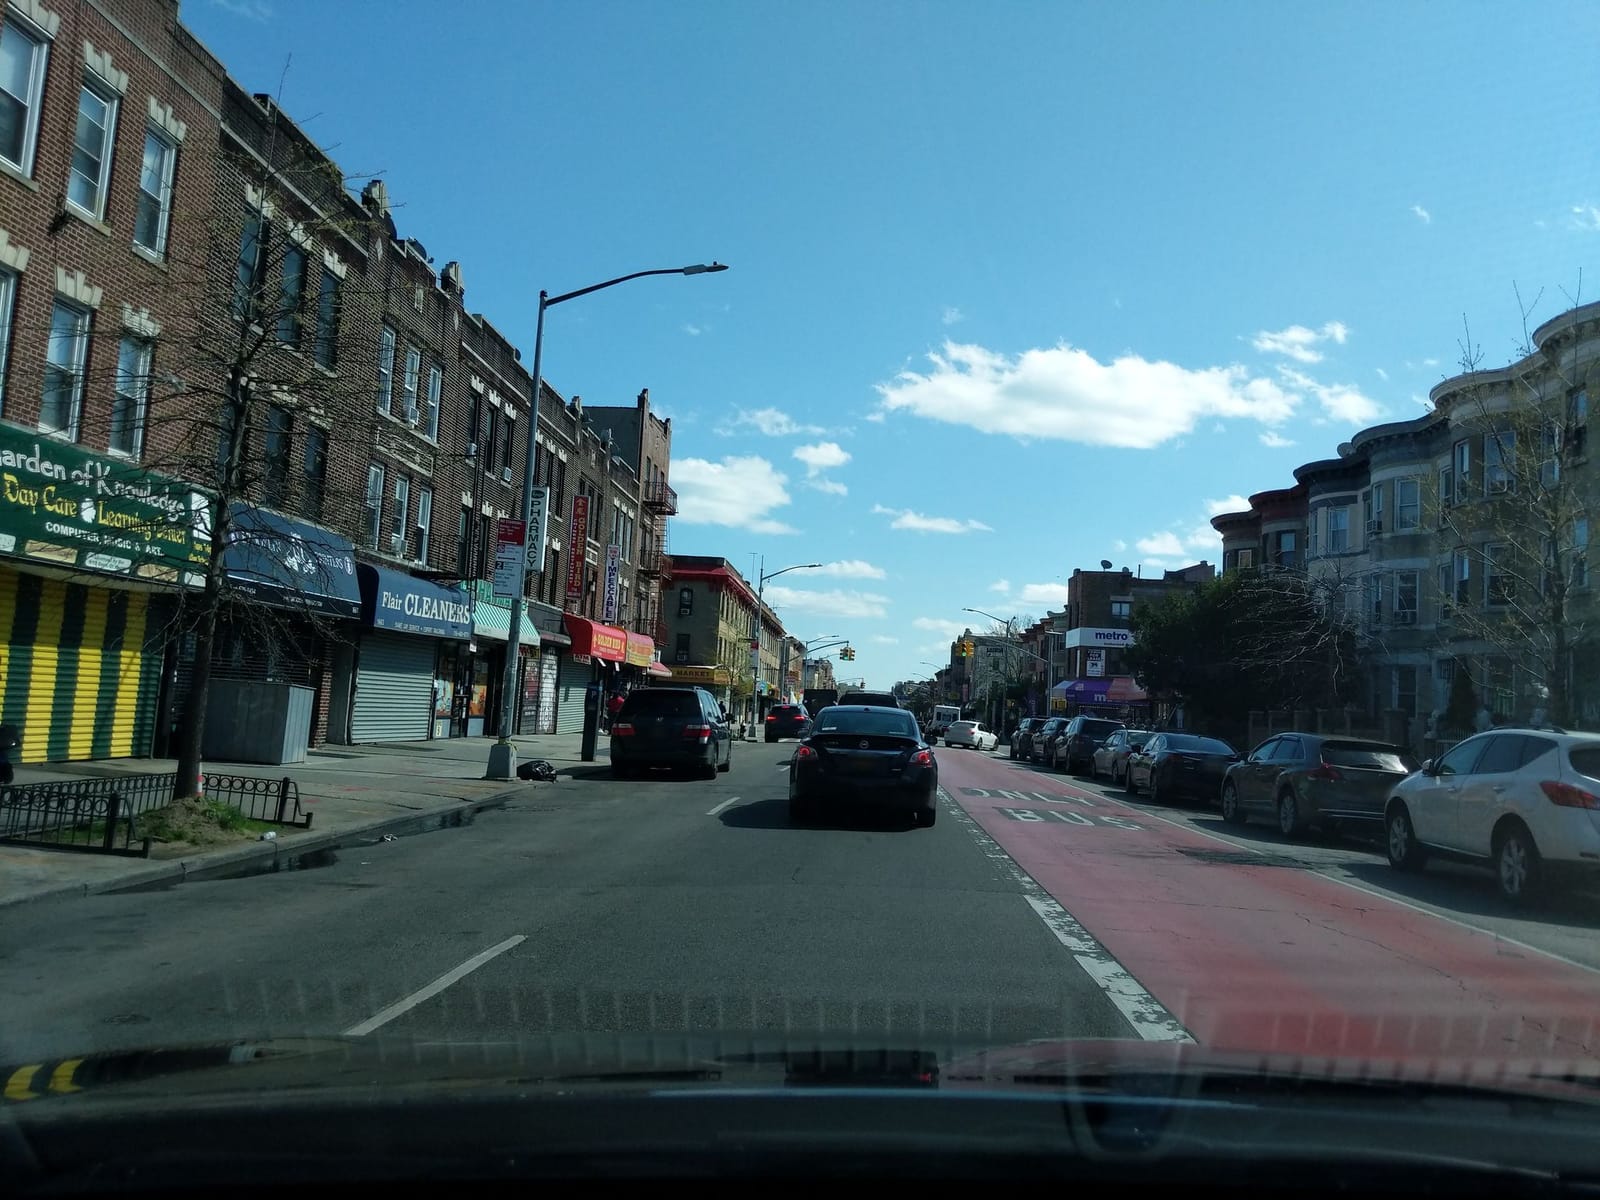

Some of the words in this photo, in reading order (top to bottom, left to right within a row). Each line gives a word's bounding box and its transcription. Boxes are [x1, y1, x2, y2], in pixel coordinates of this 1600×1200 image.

[0, 444, 66, 480] arden
[71, 460, 94, 488] of
[3, 472, 39, 514] Day
[43, 485, 77, 517] Care
[98, 500, 152, 541] Learning
[526, 500, 541, 567] PHARMACY
[382, 591, 403, 611] Flair
[404, 593, 471, 625] CLEANERS
[606, 560, 617, 619] IMPECCABLE
[1095, 631, 1128, 641] metro
[676, 669, 709, 678] MARKET
